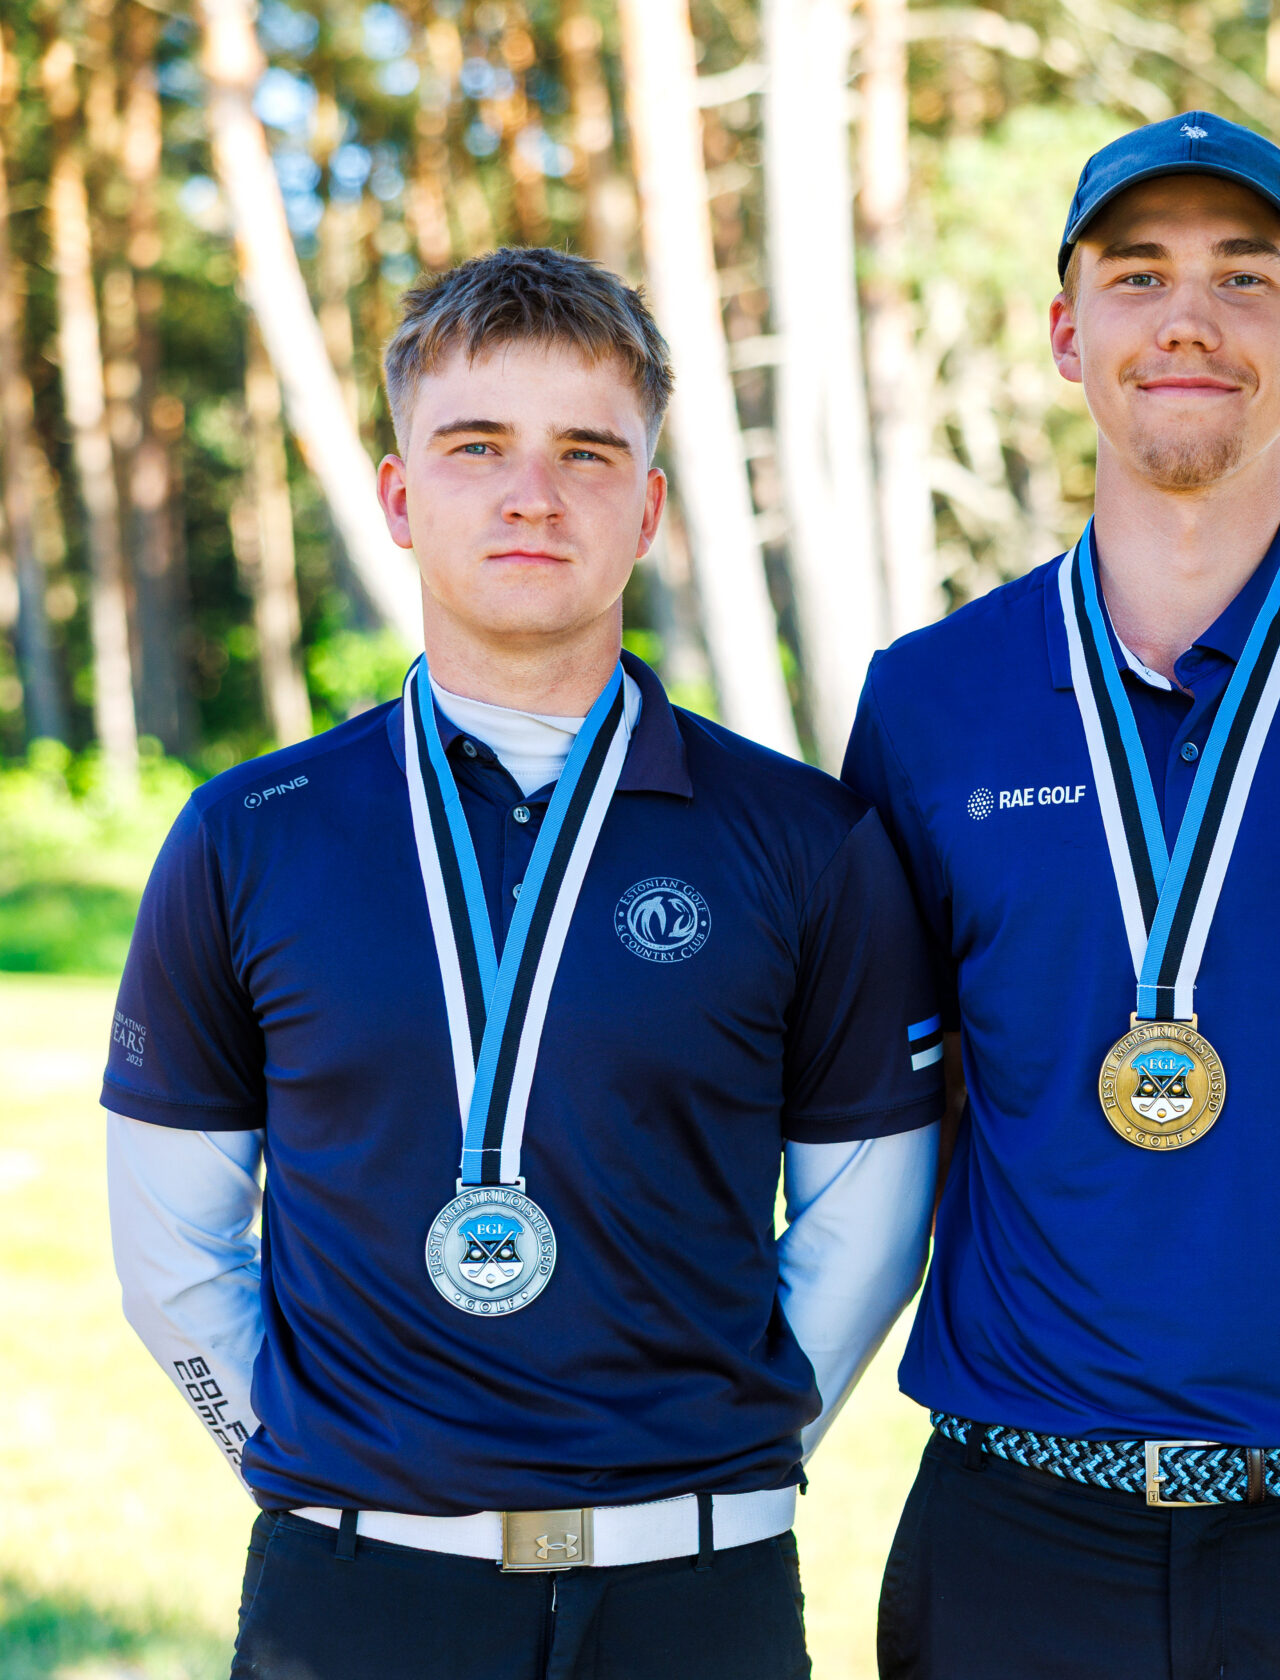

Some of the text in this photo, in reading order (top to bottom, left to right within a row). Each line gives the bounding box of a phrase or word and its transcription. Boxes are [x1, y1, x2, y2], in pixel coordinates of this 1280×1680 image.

[262, 775, 309, 800] PING
[999, 785, 1086, 809] RAE GOLF
[620, 879, 707, 912] ESTONIAN GOLF
[620, 933, 675, 961] COUNTRY
[681, 933, 705, 958] CLUB
[113, 1021, 145, 1054] EARS
[126, 1052, 143, 1067] 2025
[1149, 1058, 1177, 1070] EGL
[1103, 1065, 1117, 1109] EESTI
[1135, 1132, 1183, 1147] GOLF
[429, 1231, 444, 1276] EESTI
[465, 1298, 515, 1313] GOLF
[188, 1356, 250, 1442] GOLF
